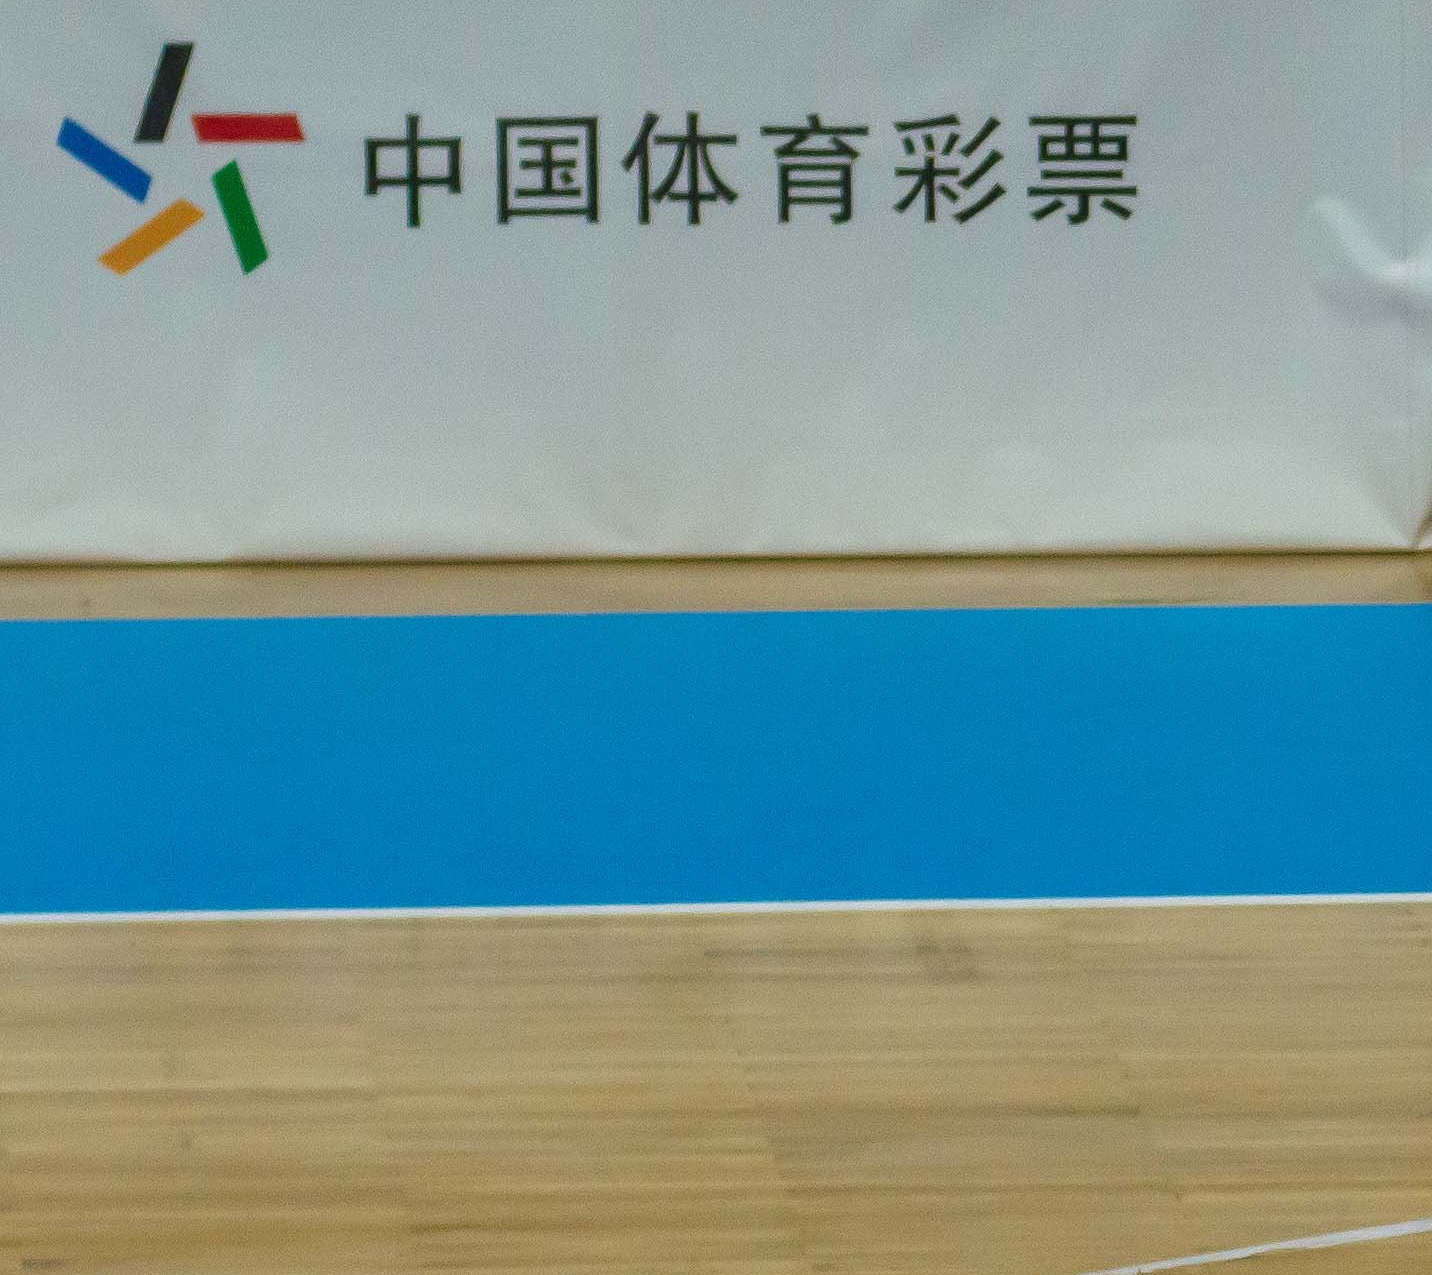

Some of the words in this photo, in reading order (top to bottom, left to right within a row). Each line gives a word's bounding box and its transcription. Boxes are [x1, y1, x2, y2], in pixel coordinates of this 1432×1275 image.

[363, 112, 1140, 228] 中国体育彩票
